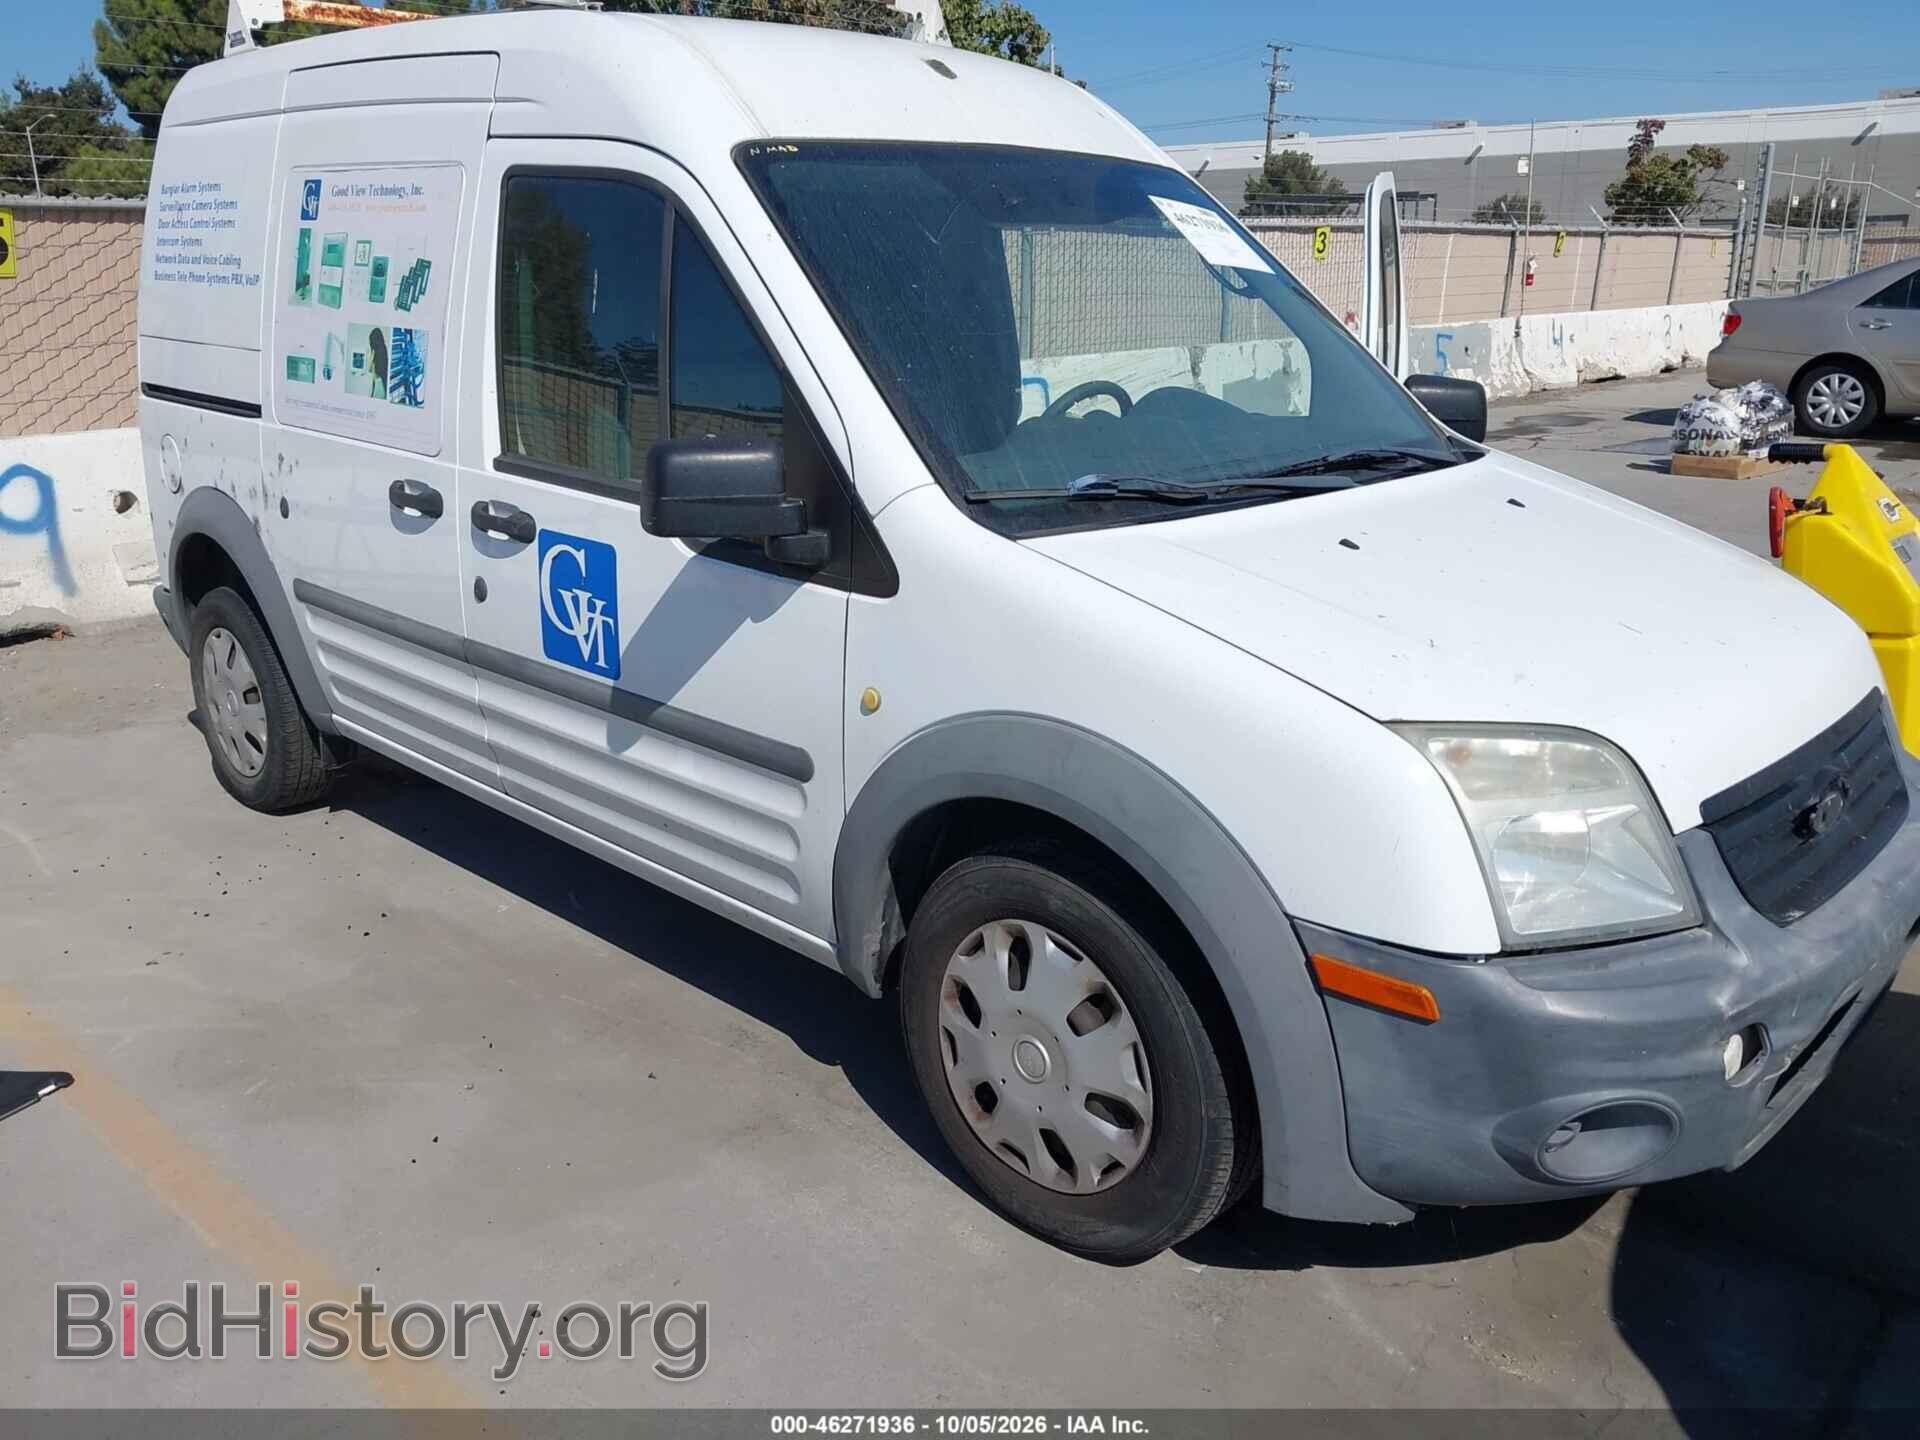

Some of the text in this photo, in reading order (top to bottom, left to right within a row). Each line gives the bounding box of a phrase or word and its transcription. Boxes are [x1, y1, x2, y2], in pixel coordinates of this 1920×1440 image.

[181, 183, 197, 194] Alarm
[198, 181, 222, 195] Systems
[331, 182, 425, 200] Good View Technology, Inc.
[192, 200, 212, 211] Camera
[213, 199, 239, 214] Systems
[158, 217, 236, 231] Door Access Control Systems
[180, 235, 202, 249] Systems
[1317, 231, 1327, 254] 3
[155, 253, 241, 270] Network Data and Voice Cabling
[154, 270, 177, 281] Business
[177, 270, 188, 281] Tele
[188, 271, 206, 282] Phone
[206, 272, 230, 286] Systems
[1434, 333, 1454, 376] 5
